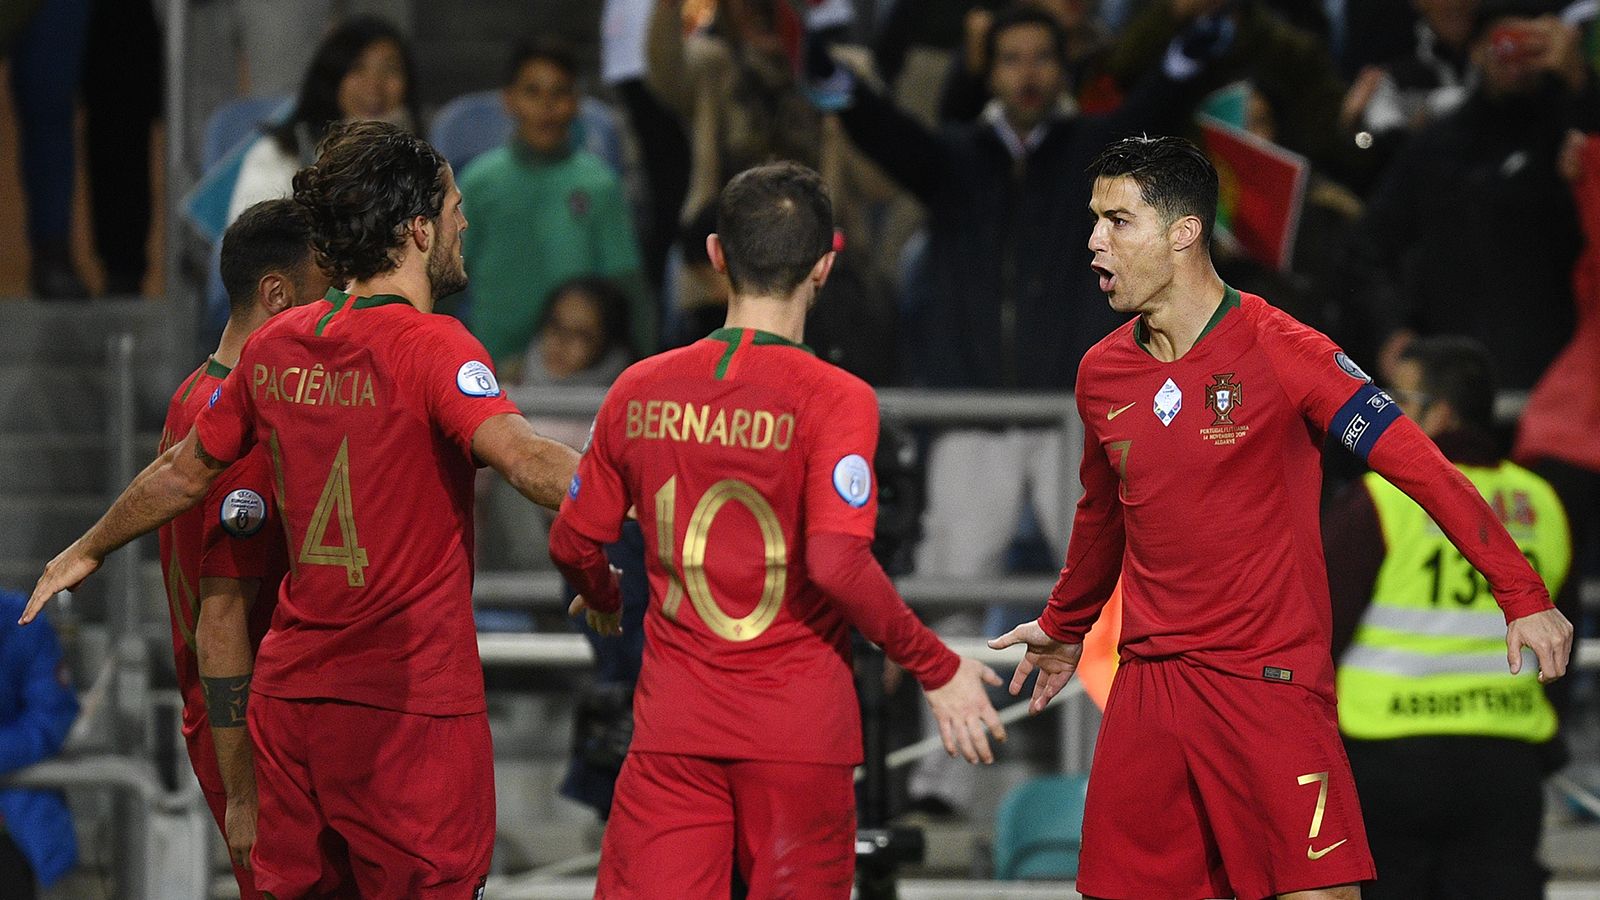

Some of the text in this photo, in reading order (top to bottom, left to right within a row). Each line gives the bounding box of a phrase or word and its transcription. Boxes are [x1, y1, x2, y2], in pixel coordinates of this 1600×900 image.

[252, 363, 376, 407] PACIÊNCIA
[626, 400, 795, 452] BERNARDO
[1344, 415, 1366, 452] SPECT
[1106, 440, 1132, 499] 7
[270, 427, 369, 587] 14
[654, 474, 788, 642] 10
[1297, 771, 1329, 839] 7
